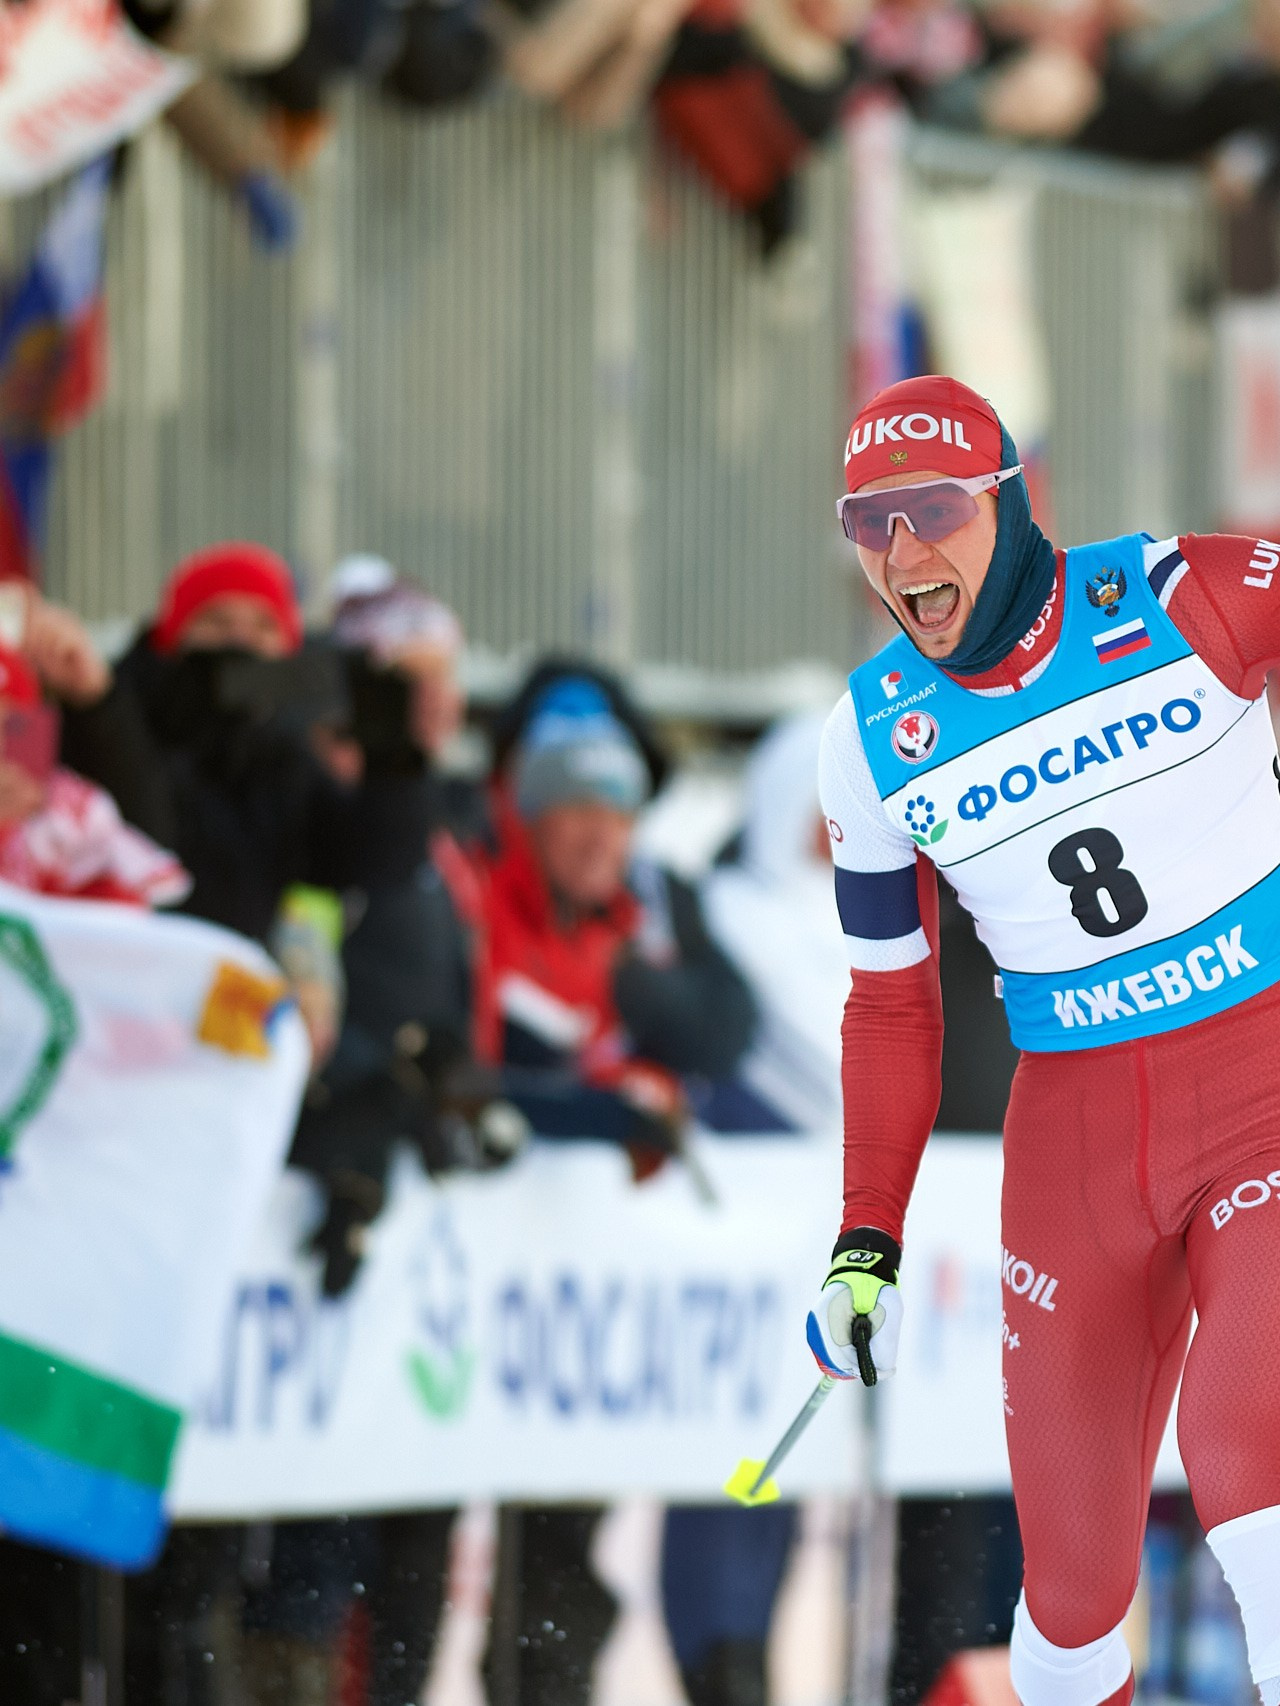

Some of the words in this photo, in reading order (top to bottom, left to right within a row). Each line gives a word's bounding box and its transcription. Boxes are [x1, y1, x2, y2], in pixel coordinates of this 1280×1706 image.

[845, 413, 972, 467] LUKOIL
[865, 682, 937, 727] РУСКЛИМАТ
[957, 698, 1201, 822] ФОСАГРО
[1048, 827, 1149, 938] 8
[1052, 924, 1260, 1029] ИЖЕВСК
[1001, 1243, 1059, 1312] KOIL
